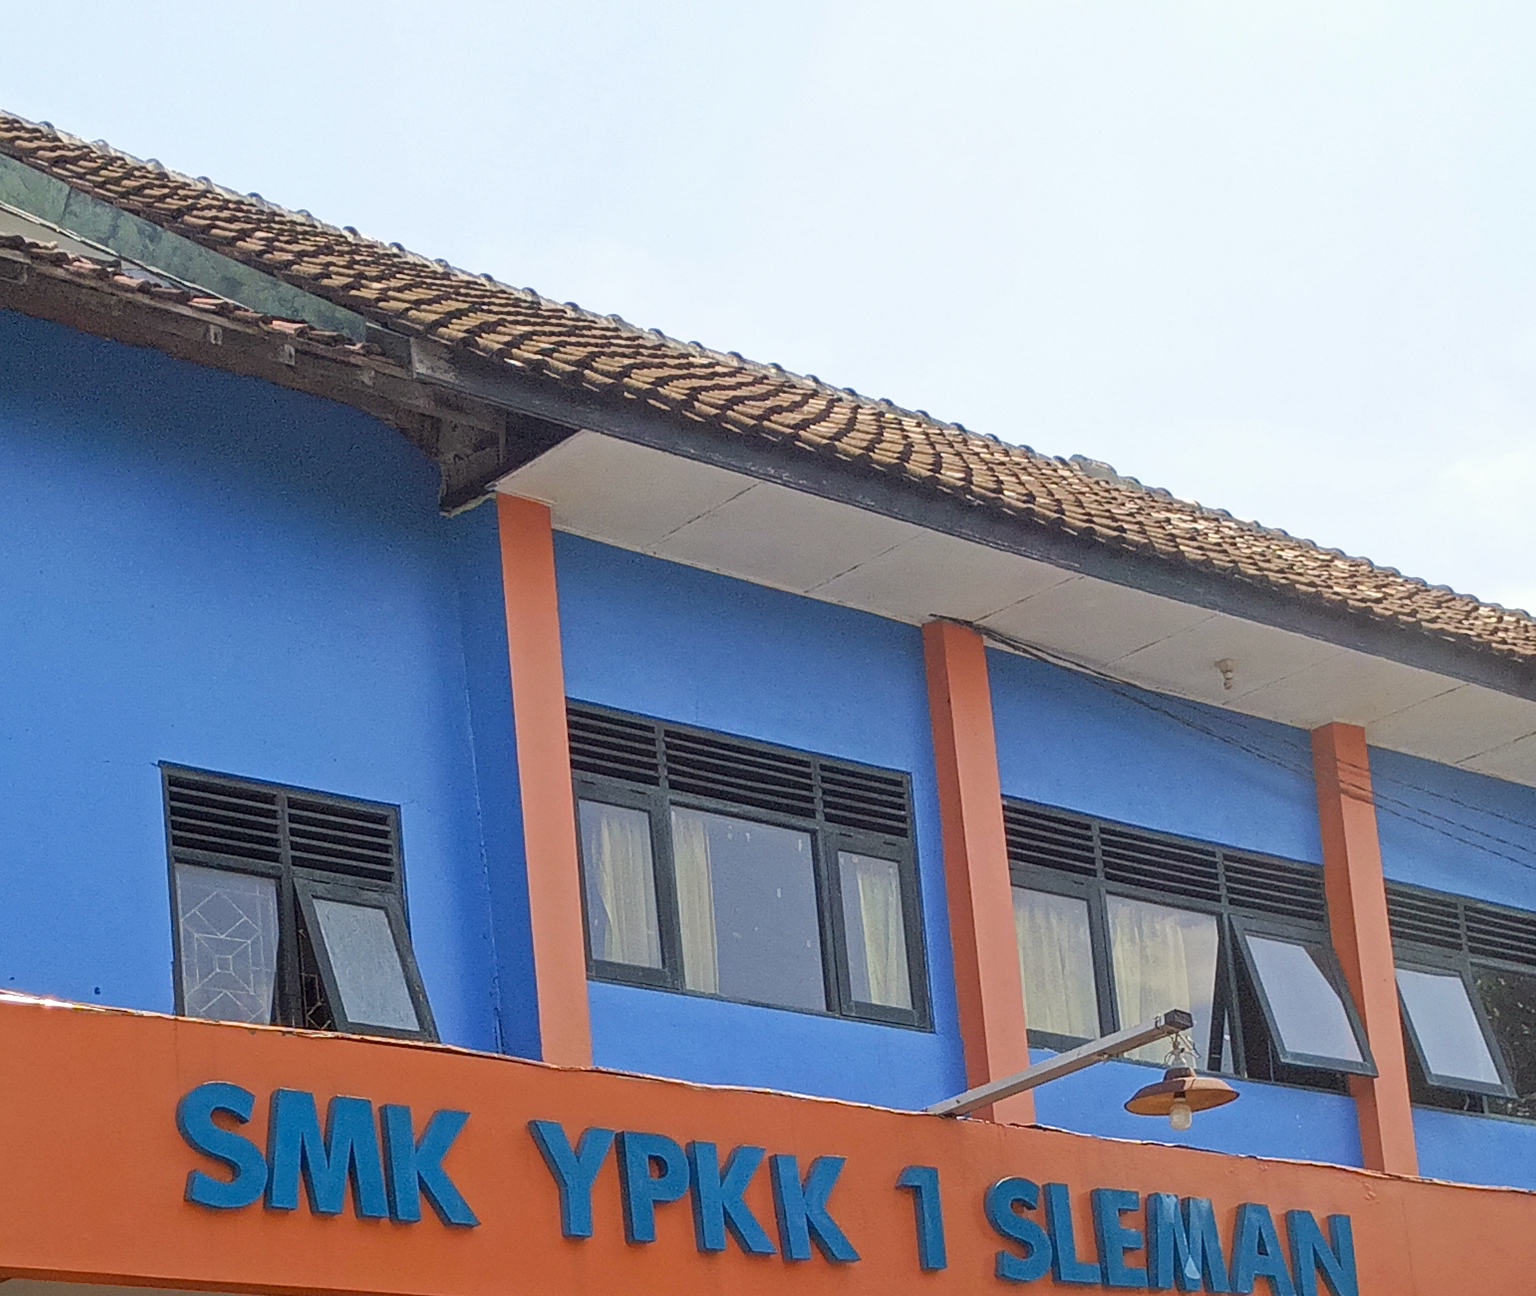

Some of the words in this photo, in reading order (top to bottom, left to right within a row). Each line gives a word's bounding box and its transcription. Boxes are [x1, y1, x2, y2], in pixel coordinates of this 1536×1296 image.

[177, 1080, 479, 1228] SMK
[529, 1119, 860, 1263] YPKK
[896, 1164, 948, 1271] 1
